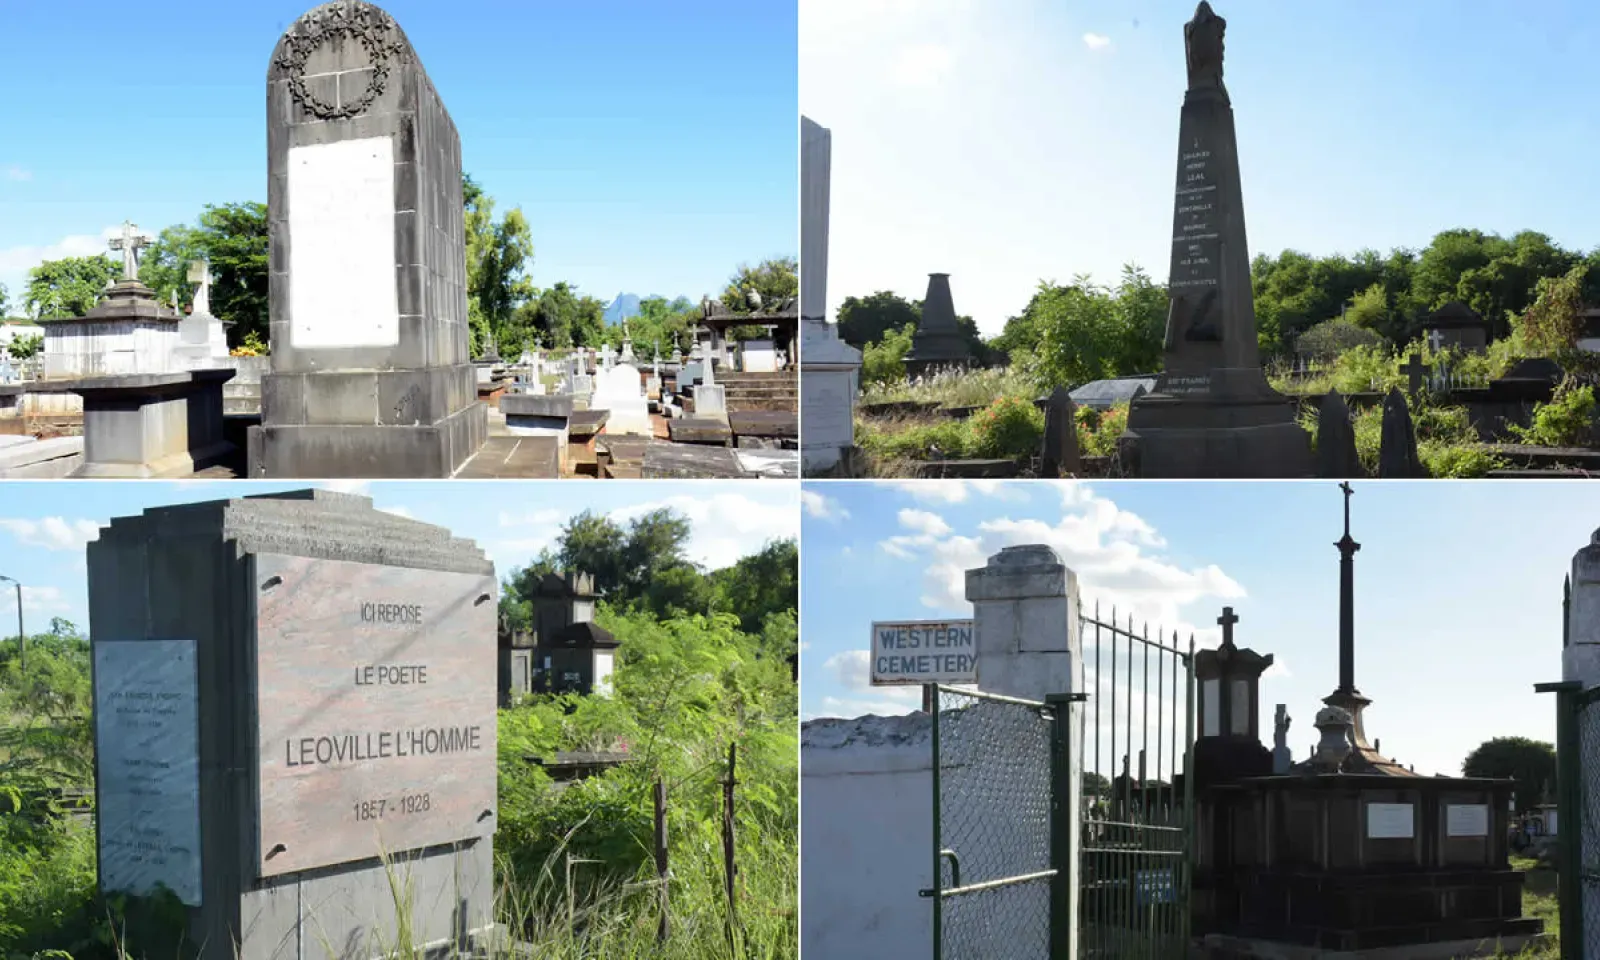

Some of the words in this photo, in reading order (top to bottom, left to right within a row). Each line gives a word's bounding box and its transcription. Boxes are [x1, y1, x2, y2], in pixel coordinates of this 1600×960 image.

[360, 602, 375, 623] ICI
[377, 603, 422, 625] REPOSE
[880, 627, 973, 650] WESTERN
[876, 653, 979, 674] CEMETERY
[354, 666, 374, 686] LE
[378, 665, 427, 685] POETE
[285, 731, 391, 767] LEOVILLE
[396, 725, 481, 758] L'HOMME
[353, 799, 386, 822] 1857
[400, 792, 431, 815] 1928
